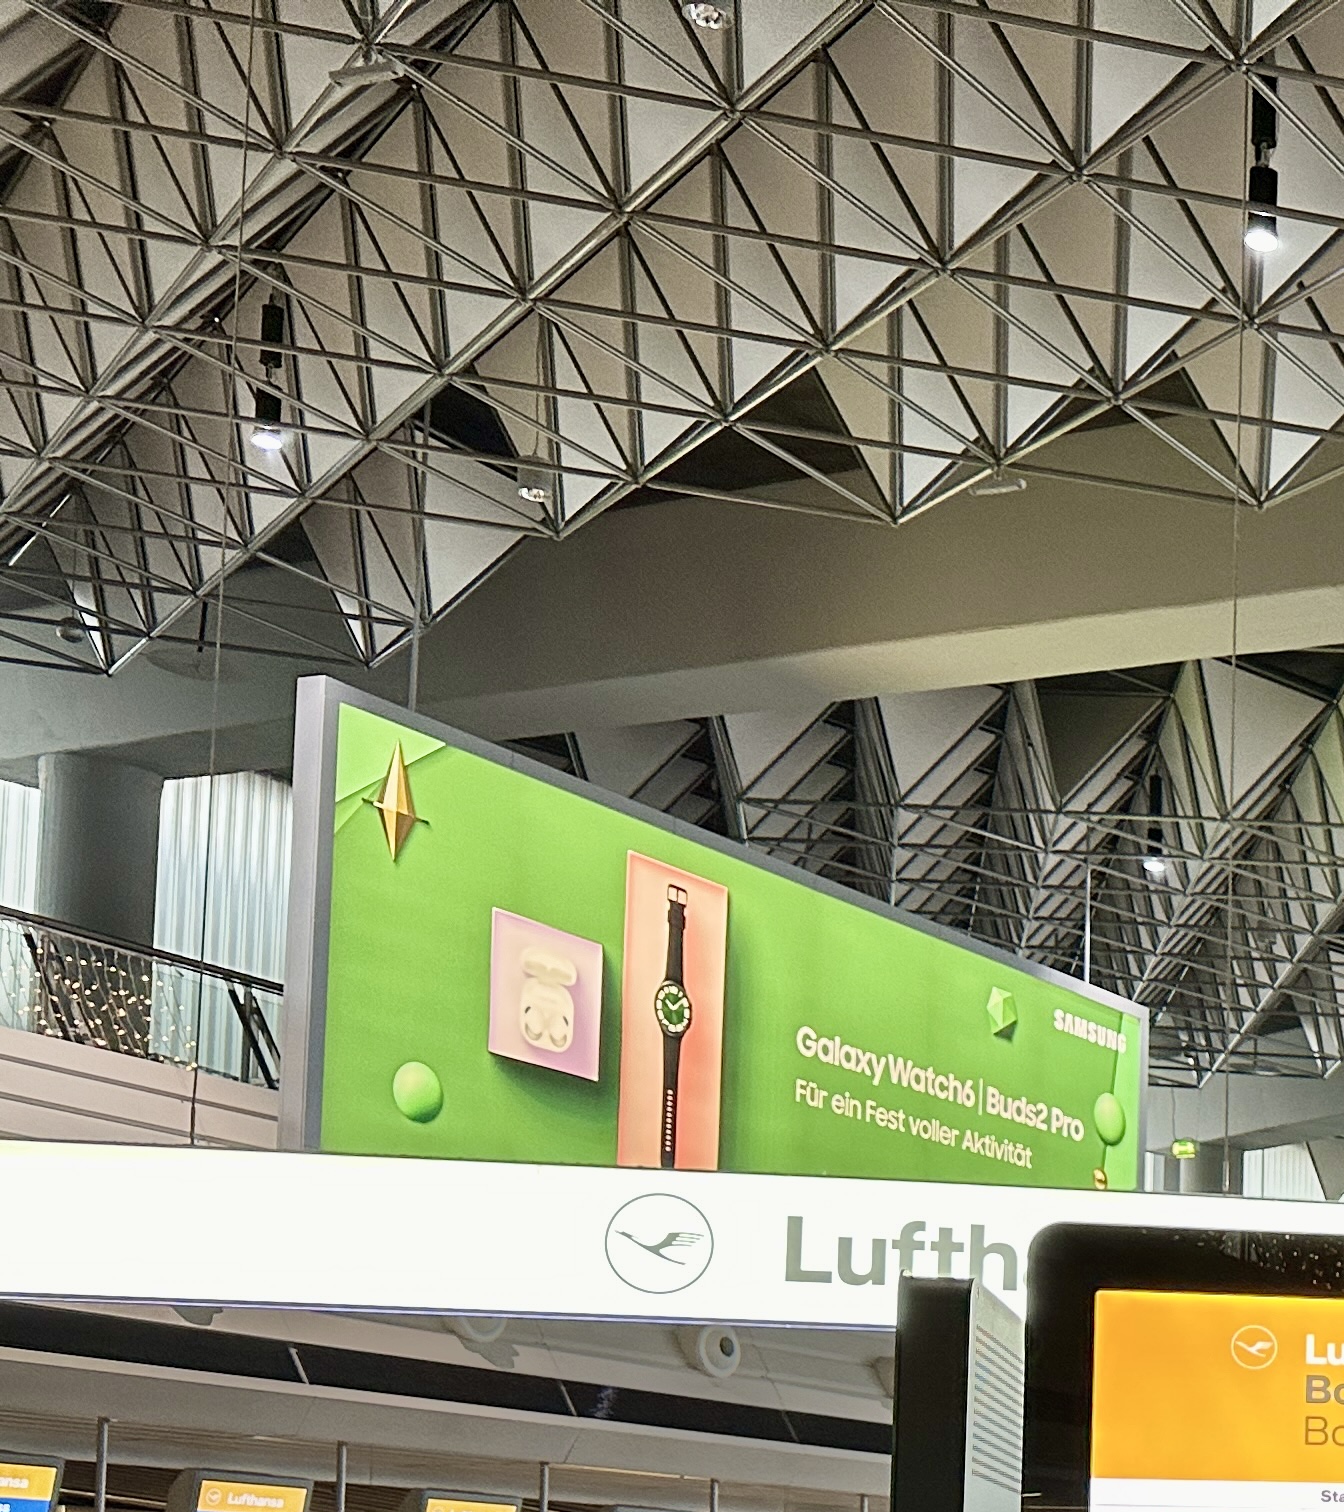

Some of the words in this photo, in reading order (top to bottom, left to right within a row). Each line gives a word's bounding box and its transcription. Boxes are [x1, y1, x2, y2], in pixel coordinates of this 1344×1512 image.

[1053, 1008, 1127, 1054] SAMSUNG
[795, 1025, 887, 1087] Galaxy
[888, 1053, 976, 1108] Watch6
[986, 1085, 1048, 1132] Buds2
[1050, 1106, 1085, 1142] Pro
[794, 1078, 828, 1109] Für
[831, 1091, 862, 1121] ein
[865, 1100, 905, 1134] Fest
[908, 1115, 960, 1148] voller
[961, 1128, 1033, 1169] Aktivität
[785, 1215, 1027, 1291] Lufth
[226, 1490, 285, 1509] Lufthansa
